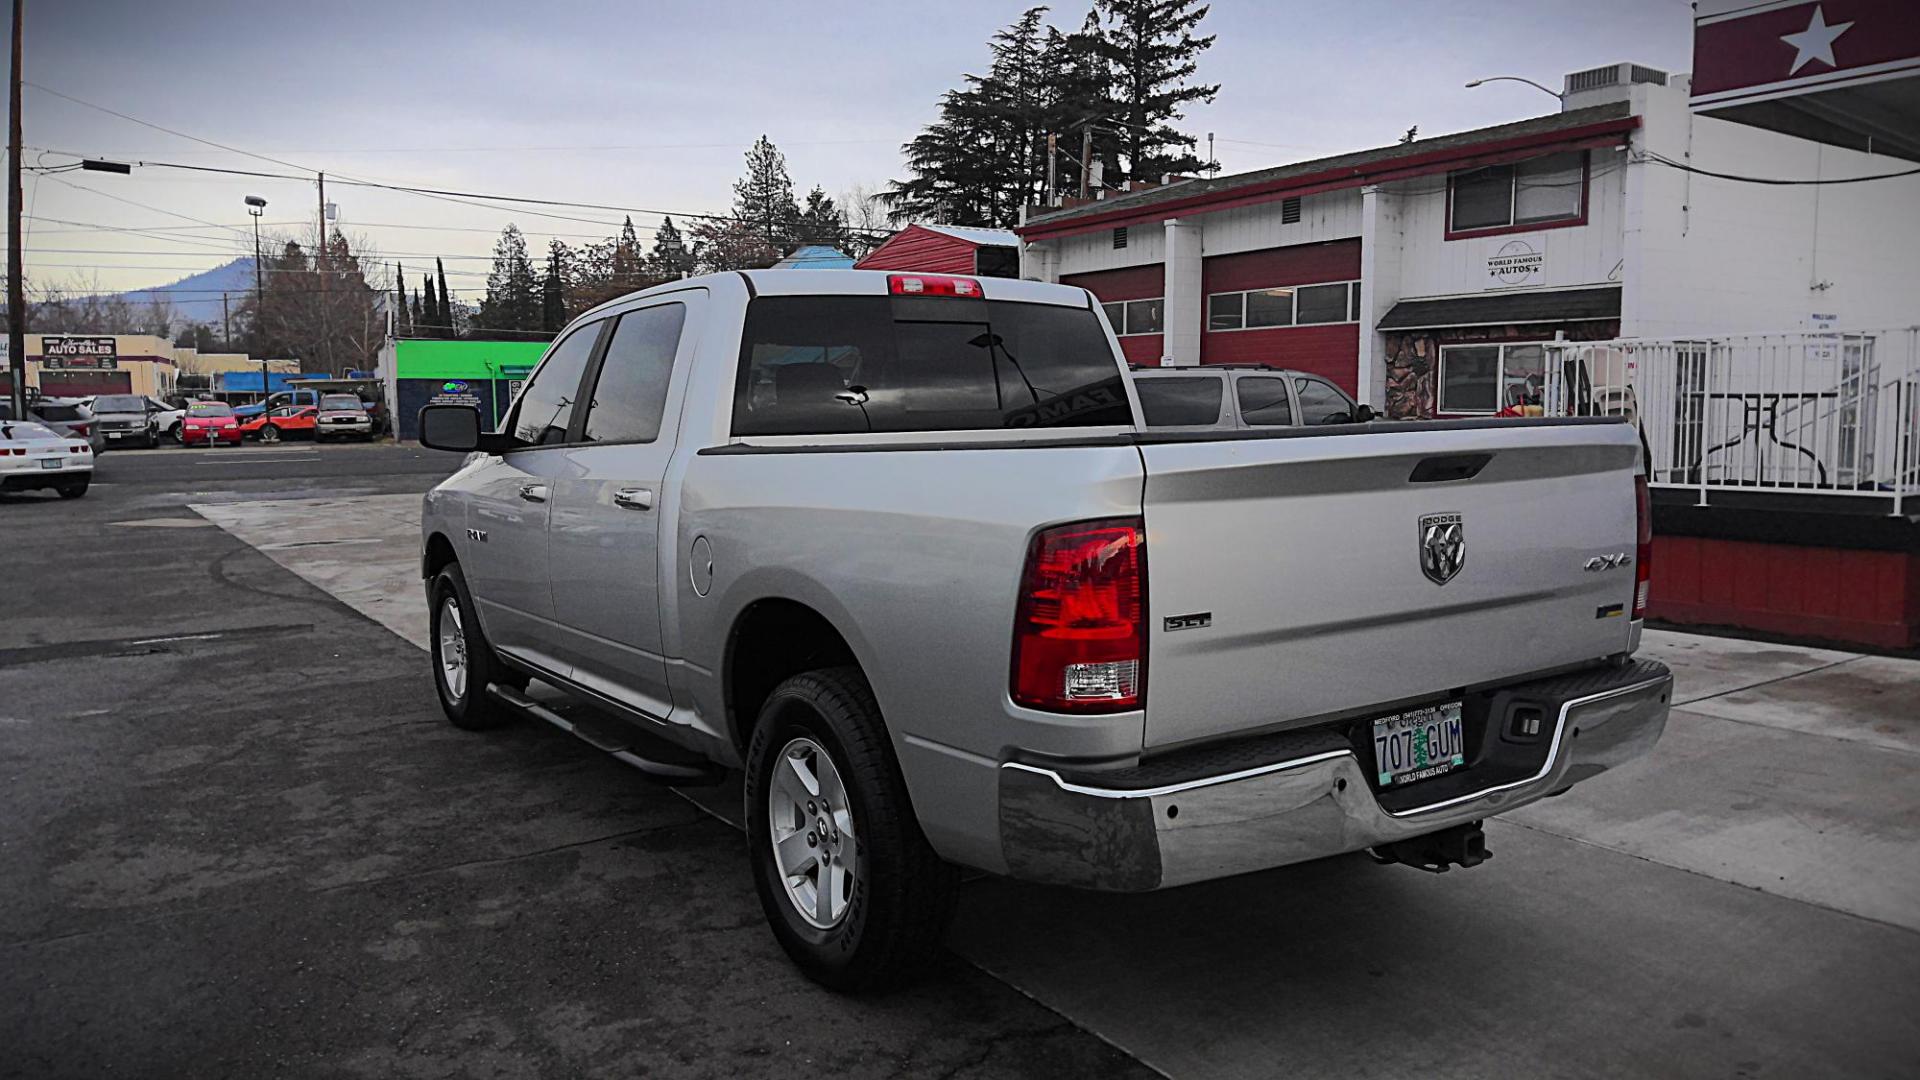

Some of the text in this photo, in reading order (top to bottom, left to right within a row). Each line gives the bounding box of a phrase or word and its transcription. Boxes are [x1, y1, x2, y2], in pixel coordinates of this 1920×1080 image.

[1488, 256, 1542, 267] WORLD FAMOUS
[1499, 265, 1531, 275] AUTOS
[48, 345, 112, 355] AUTO SALES
[1424, 515, 1462, 525] DODGE
[1166, 613, 1211, 630] SLT
[1374, 715, 1400, 725] MEDFORD
[1440, 701, 1463, 711] OREGON
[1376, 719, 1462, 772] 707 GUM
[1399, 773, 1416, 783] WORLD
[1416, 767, 1436, 780] FAMOUS
